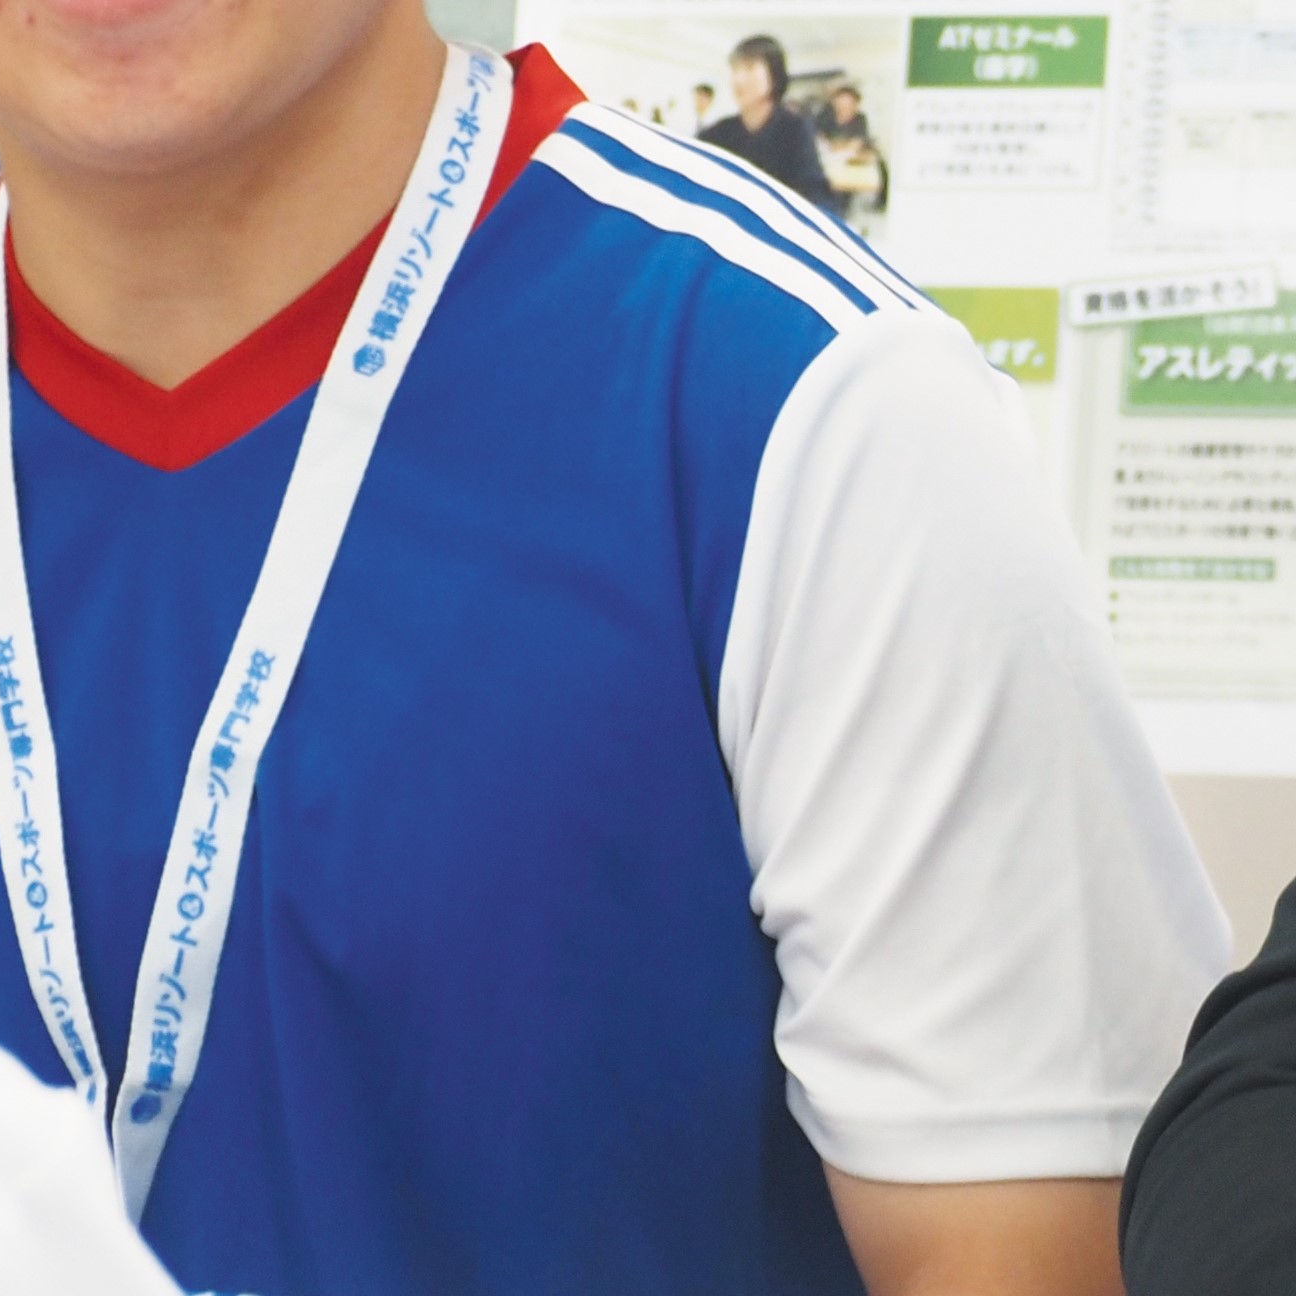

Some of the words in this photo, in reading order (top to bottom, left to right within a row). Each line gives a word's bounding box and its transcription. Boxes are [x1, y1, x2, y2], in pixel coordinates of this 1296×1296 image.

[938, 23, 1078, 50] ATゼミナール
